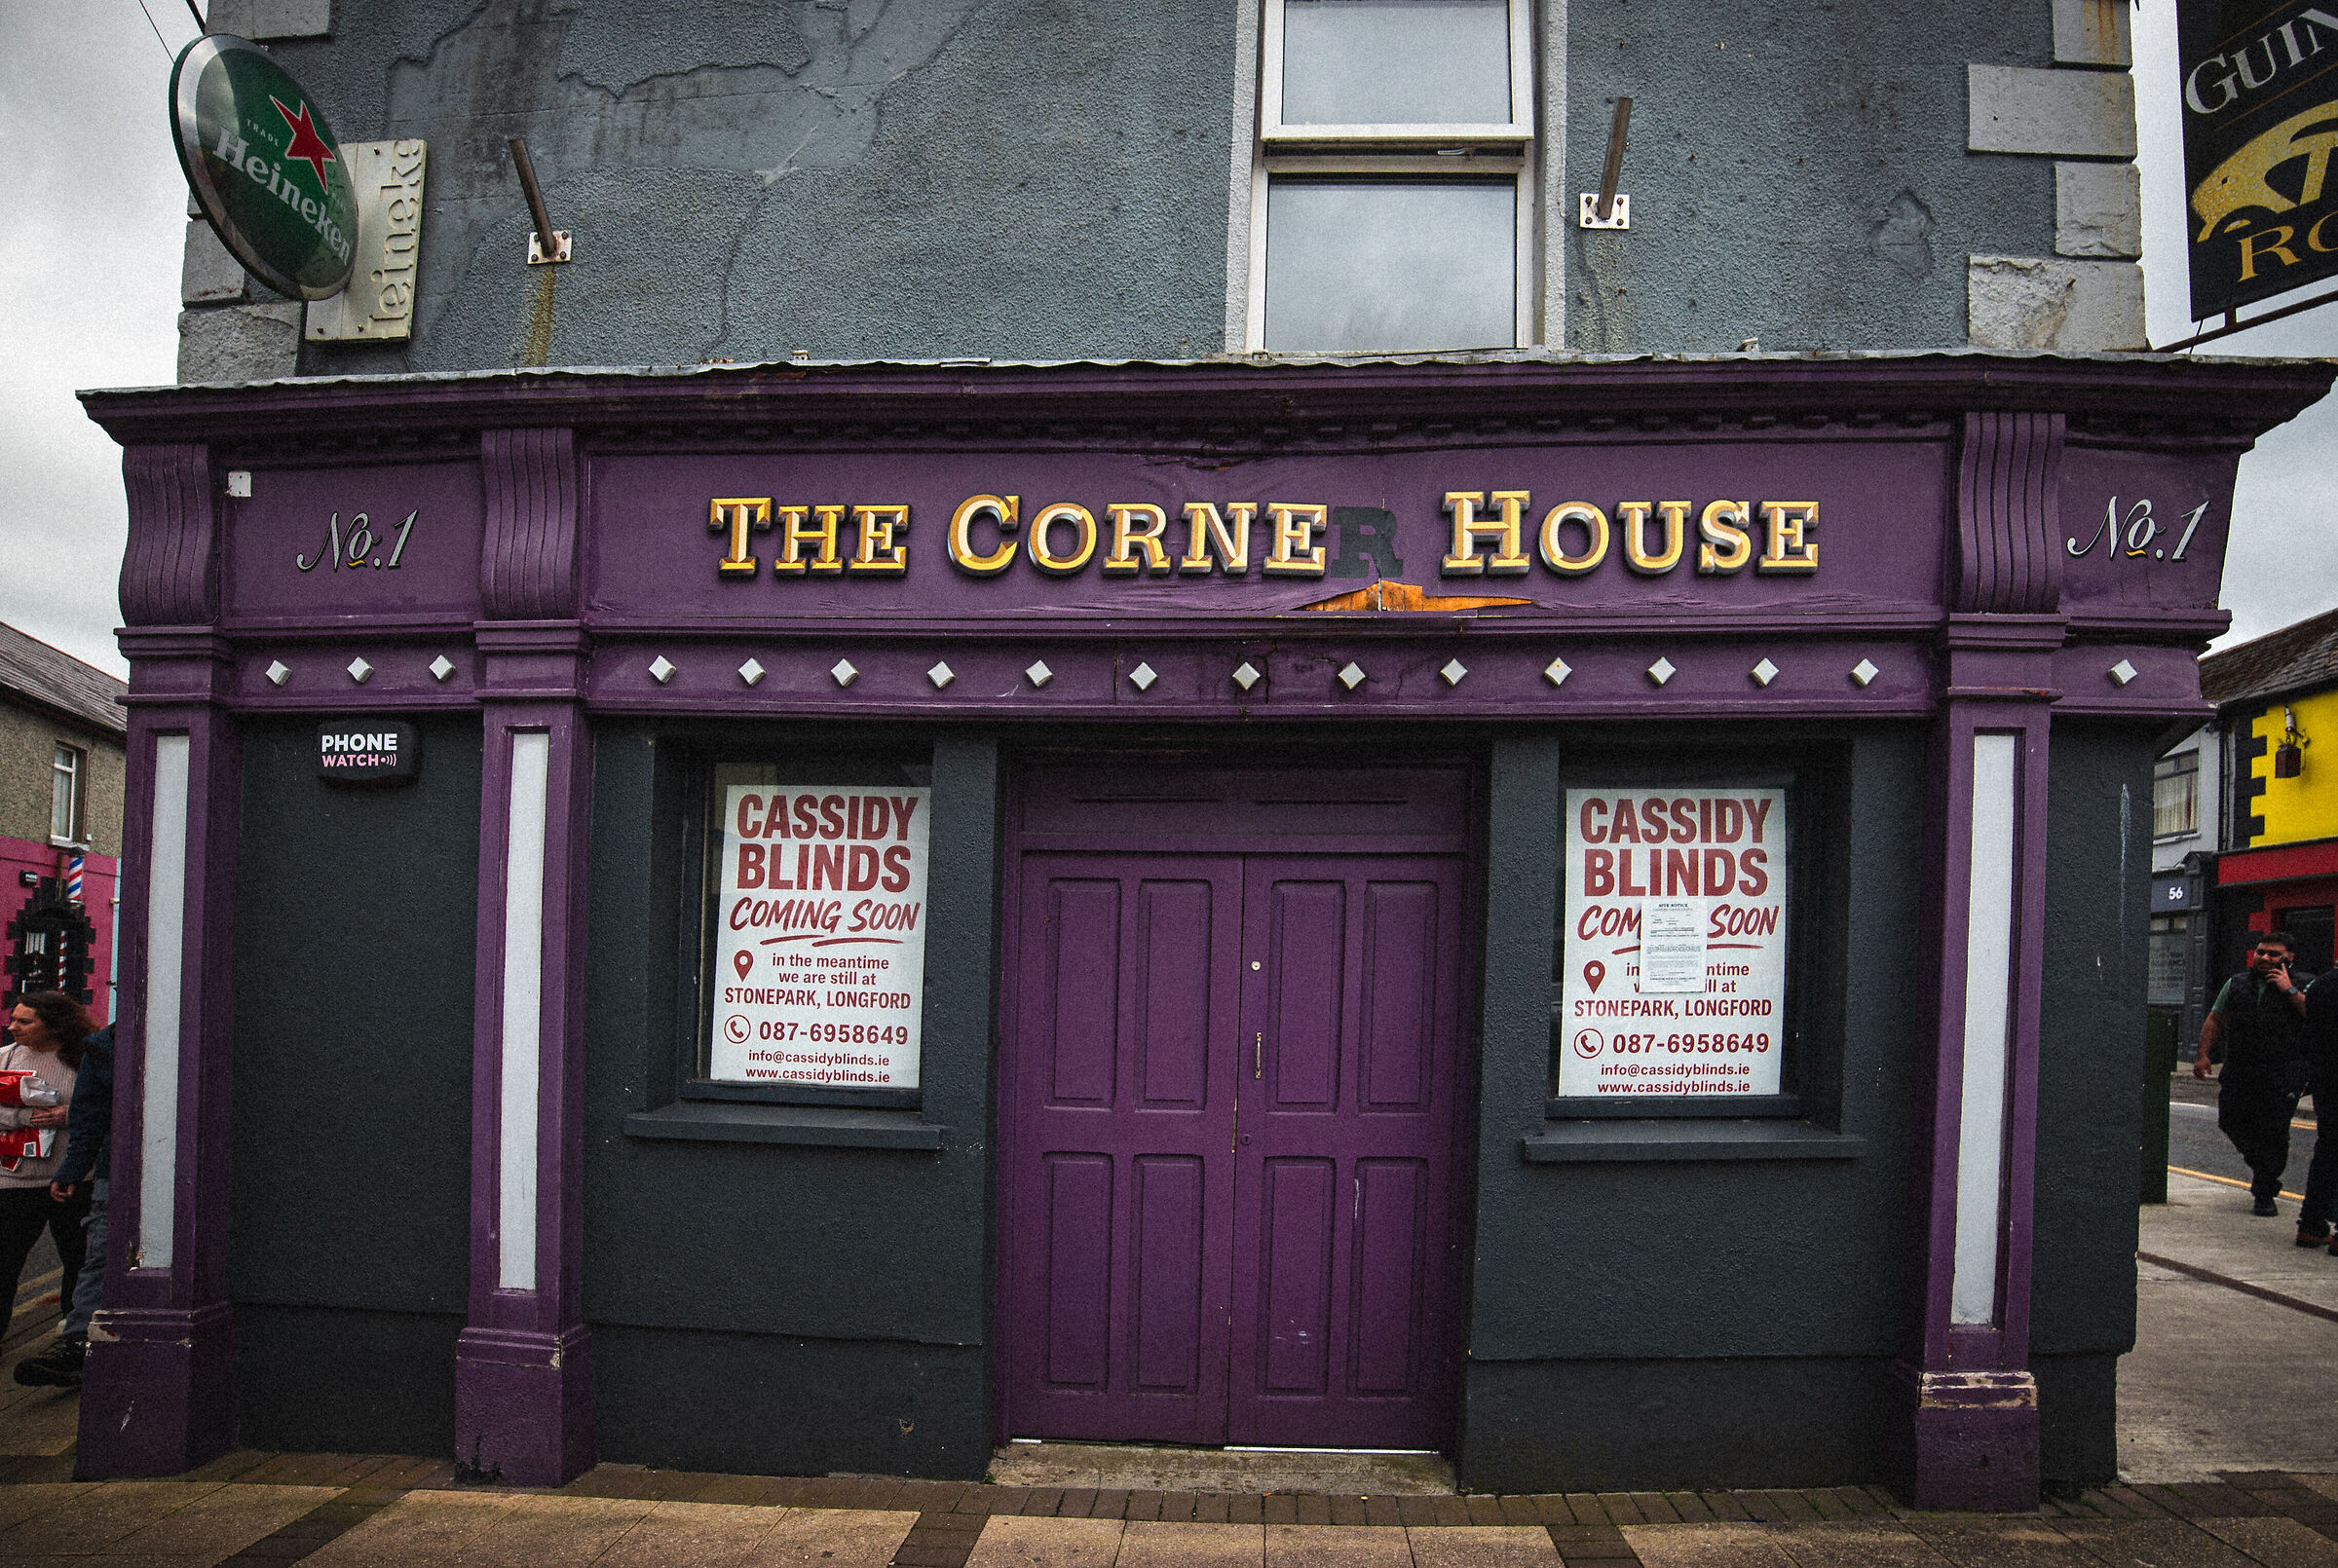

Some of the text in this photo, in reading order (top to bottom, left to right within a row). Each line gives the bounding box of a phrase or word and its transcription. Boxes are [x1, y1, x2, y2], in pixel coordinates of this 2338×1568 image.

[246, 119, 280, 147] TRADE
[212, 126, 352, 266] Heineken
[707, 490, 1821, 579] THE CORNER HOUSE
[321, 733, 397, 752] PHONE
[321, 754, 379, 767] WATCH
[736, 793, 920, 841] CASSIDY
[1579, 797, 1773, 844] CASSIDY
[736, 842, 912, 893] BLINDS
[1584, 847, 1769, 897] BLINDS
[2168, 886, 2183, 900] 56
[729, 896, 921, 934] COMING SOON
[1707, 903, 1780, 939] SOON
[772, 952, 889, 970] in the meantime
[1626, 962, 1640, 977] in
[779, 970, 877, 986] we are still at
[1721, 980, 1737, 993] at
[724, 987, 912, 1010] STONEPARK, LONGFORD
[1574, 999, 1773, 1020] STONEPARK, LONGFORD
[759, 1021, 909, 1046] 087-6958649
[1612, 1032, 1770, 1054] 087-6958649
[748, 1049, 890, 1067] info@cassidyblinds.ie
[745, 1067, 891, 1084] www.cassidyblinds.ie
[1601, 1063, 1751, 1078] info@cassidyblinds.ie
[1598, 1079, 1752, 1096] www.cassidyblinds.ie
